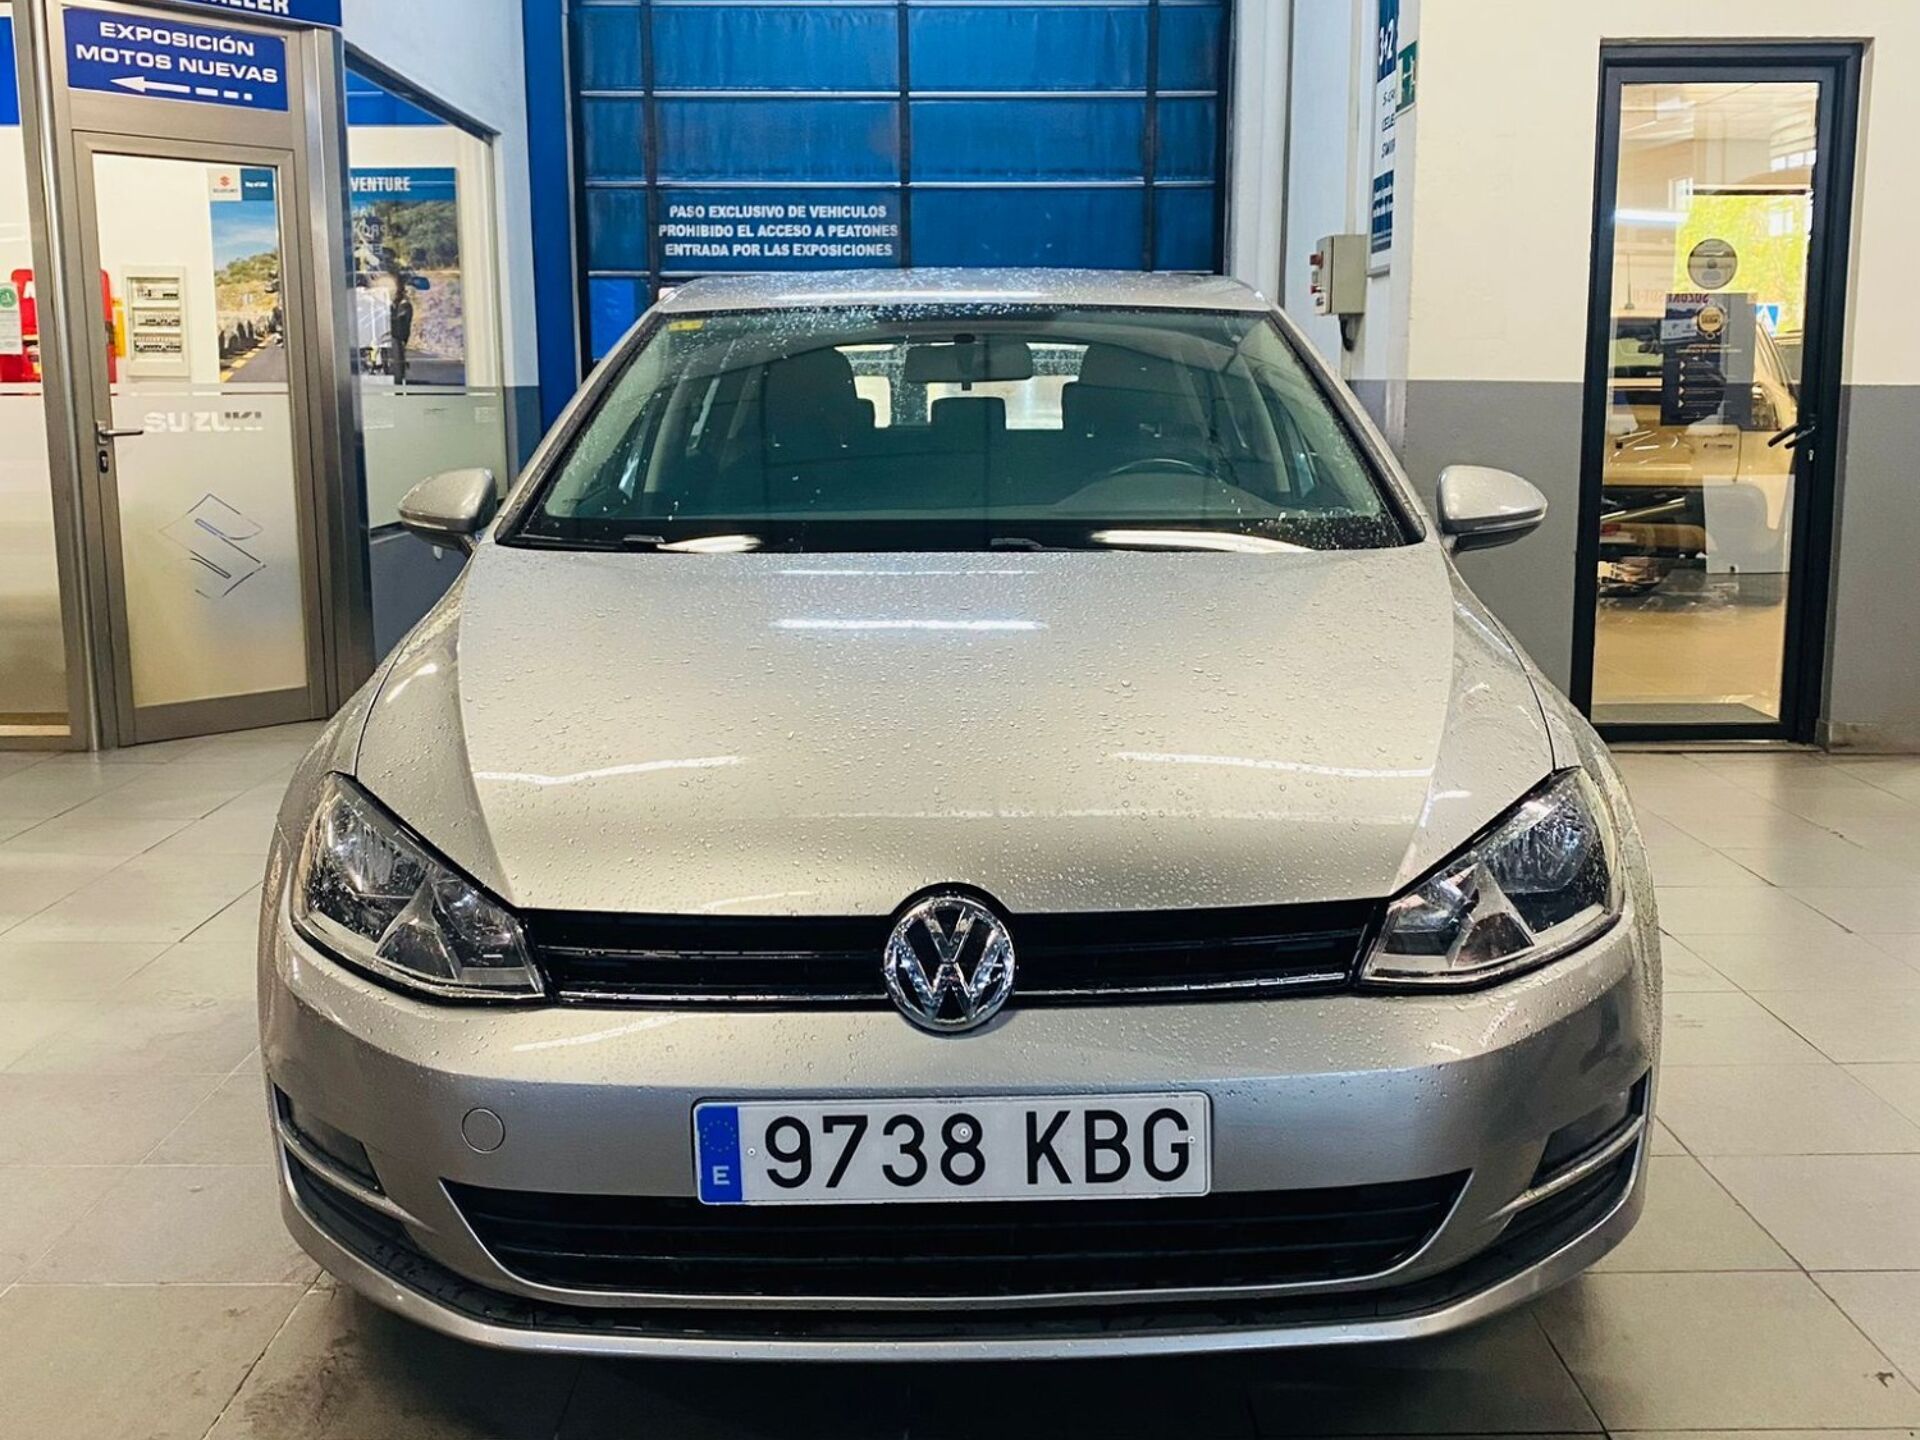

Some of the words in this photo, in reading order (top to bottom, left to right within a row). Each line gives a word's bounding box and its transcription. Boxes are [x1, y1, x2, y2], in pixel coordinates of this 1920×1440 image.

[100, 21, 255, 57] EXPOSICIÓN
[76, 44, 173, 71] MOTOS
[179, 57, 279, 84] NUEVAS
[350, 176, 411, 192] VENTURE
[669, 205, 705, 218] PASO
[709, 205, 784, 218] EXCLUSIVO
[788, 205, 806, 218] DE
[809, 205, 887, 218] VEHICULOS
[658, 224, 733, 238] PROHIBIDO
[737, 224, 754, 237] EL
[757, 224, 812, 237] ACCESO
[814, 224, 825, 237] A
[828, 224, 898, 237] PEATONES
[665, 244, 729, 257] ENTRADA
[733, 244, 760, 257] POR
[764, 243, 790, 257] LAS
[793, 243, 893, 257] EXPOSICIONES
[765, 1112, 986, 1189] 9738
[1026, 1107, 1190, 1185] KBG
[712, 1165, 730, 1185] E
